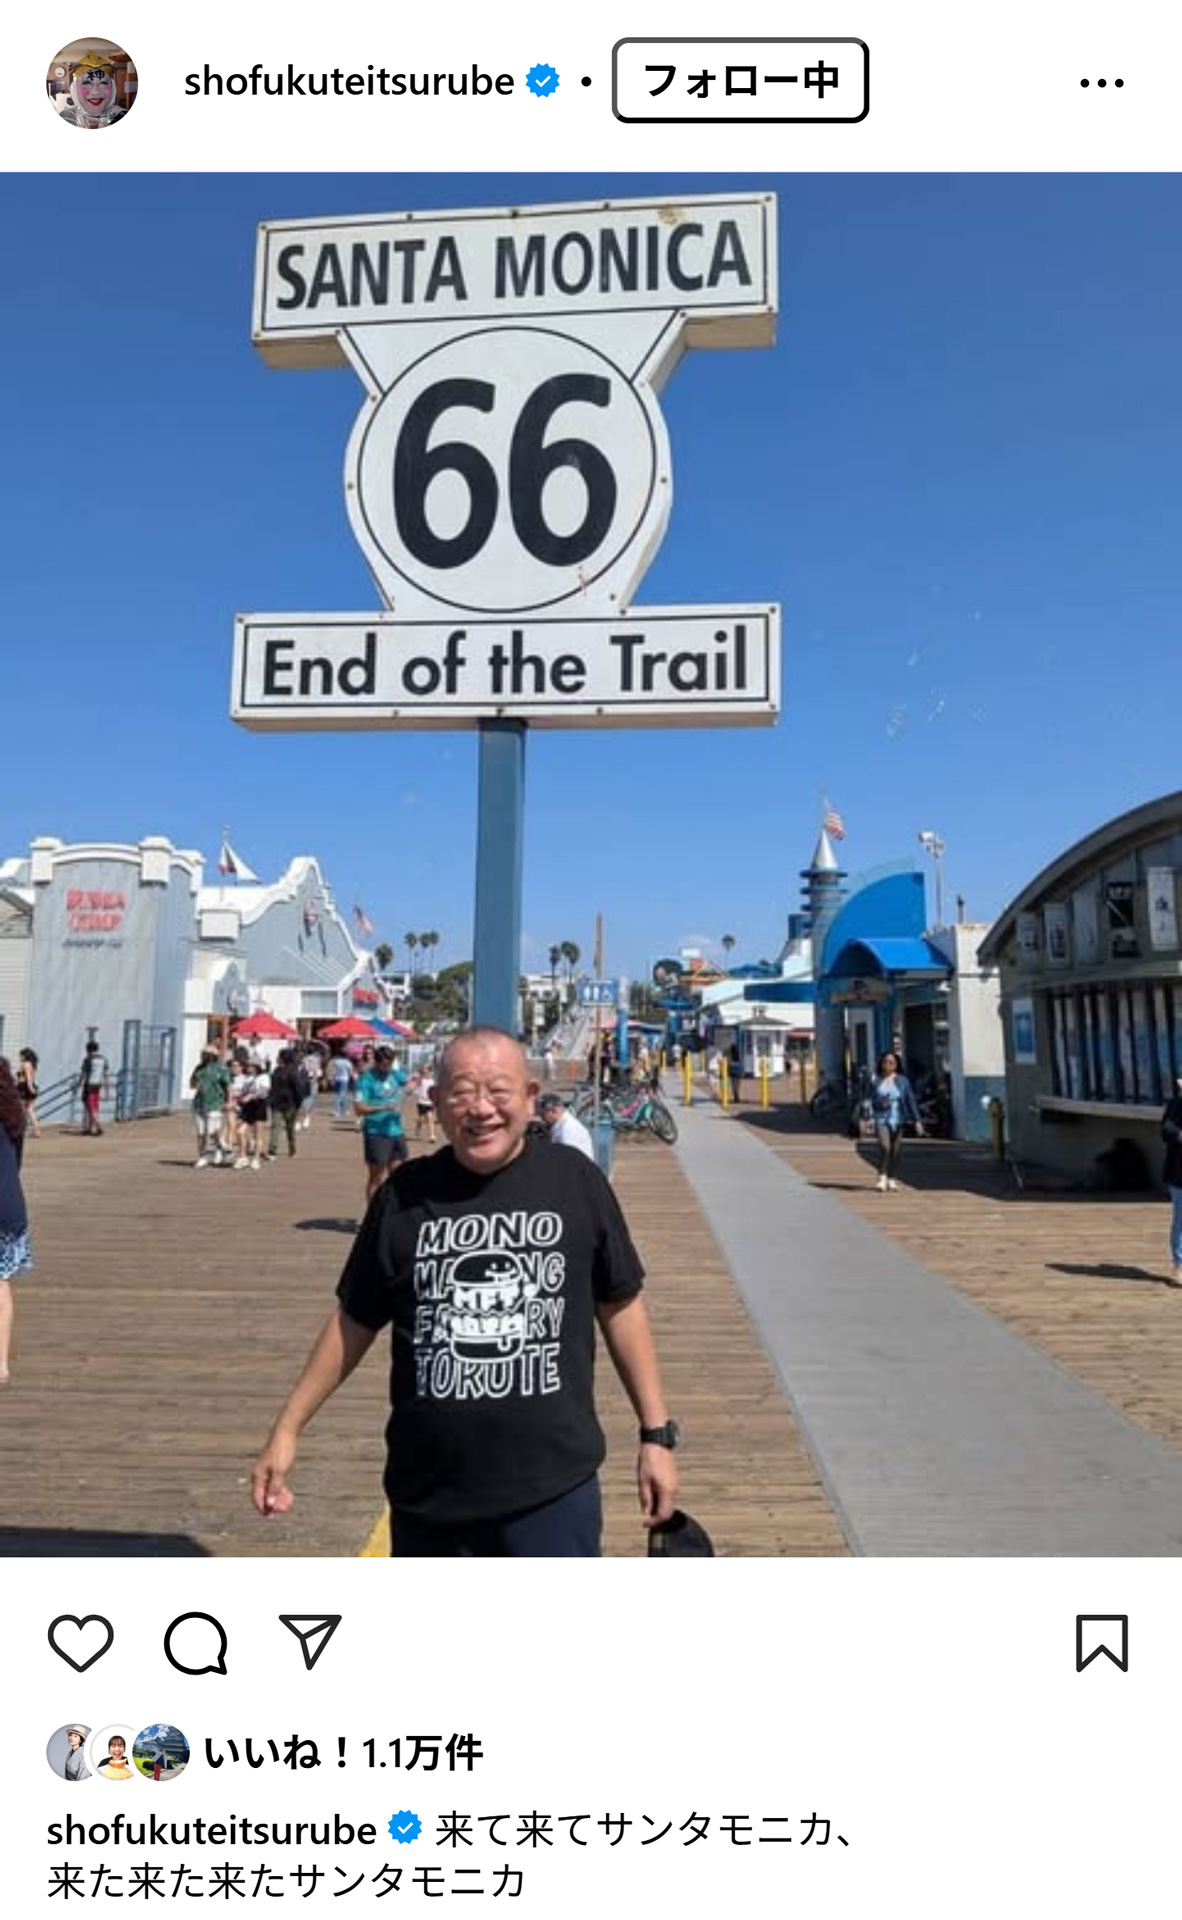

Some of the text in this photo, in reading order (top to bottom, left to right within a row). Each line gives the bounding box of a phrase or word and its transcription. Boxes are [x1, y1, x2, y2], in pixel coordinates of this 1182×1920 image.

[87, 69, 105, 81] 神
[278, 219, 751, 309] SANTA MONICA
[393, 373, 617, 570] 66
[264, 625, 747, 696] End of the Trail
[416, 1212, 563, 1257] MONO
[414, 1343, 561, 1400] TOKUTE
